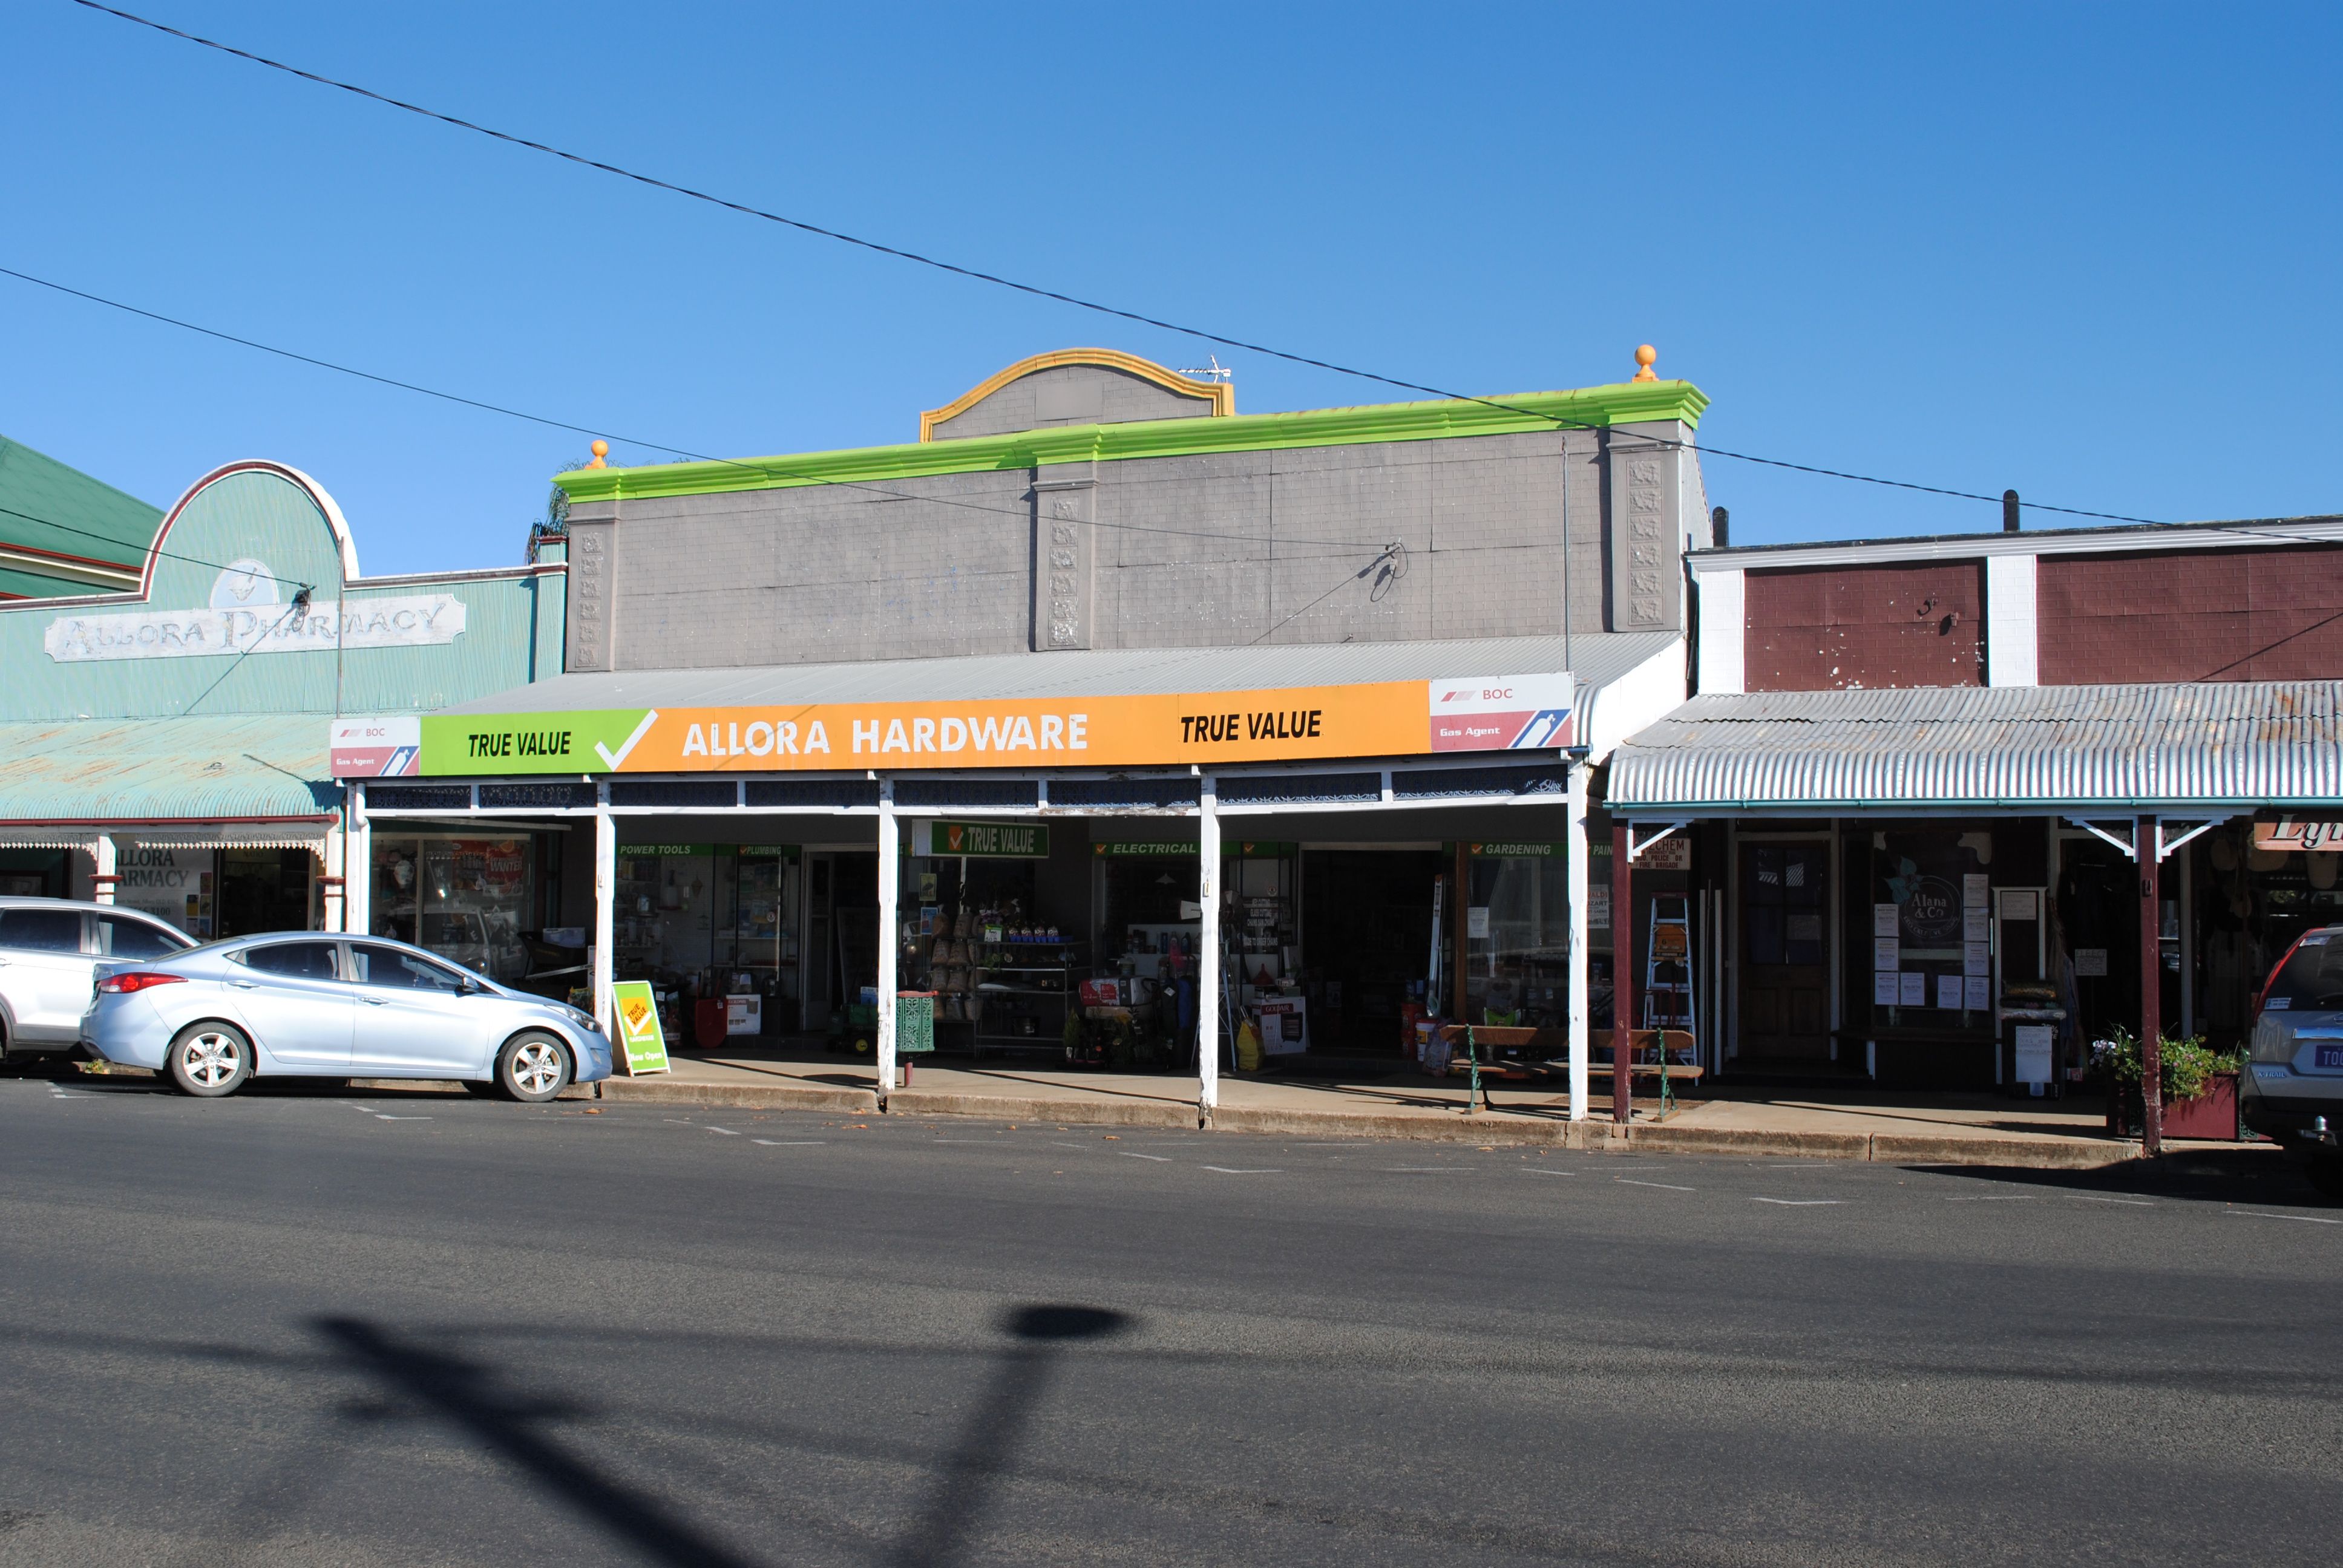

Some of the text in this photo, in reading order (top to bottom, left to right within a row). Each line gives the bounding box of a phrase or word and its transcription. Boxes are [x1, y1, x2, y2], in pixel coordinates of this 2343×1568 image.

[65, 604, 447, 654] ALLORA PHARMACY
[1483, 688, 1513, 700] BOC
[365, 728, 385, 737] BOC
[1180, 710, 1323, 743] TRUE VALUE
[1440, 727, 1501, 737] Gas Agent
[681, 714, 1089, 757] ALLORA HARDWARE
[468, 731, 572, 757] TRUE VALUE
[353, 757, 375, 766] Agent
[968, 826, 1035, 853] TRUE VALUE
[1646, 839, 1684, 851] ZCHEM
[620, 845, 691, 854] POWER TOOLS
[747, 845, 782, 855] PLUMBING
[1112, 843, 1196, 854] ELECTRICAL
[1486, 843, 1551, 855] GARDENING
[1593, 844, 1613, 856] PAIN
[117, 869, 189, 887] ARMACY
[1911, 893, 1948, 907] Alana
[1914, 907, 1944, 919] & Co
[627, 1003, 641, 1019] TRUE
[1265, 1004, 1289, 1013] GOLDAIR
[631, 1006, 647, 1025] VALUE
[644, 1051, 663, 1062] Open
